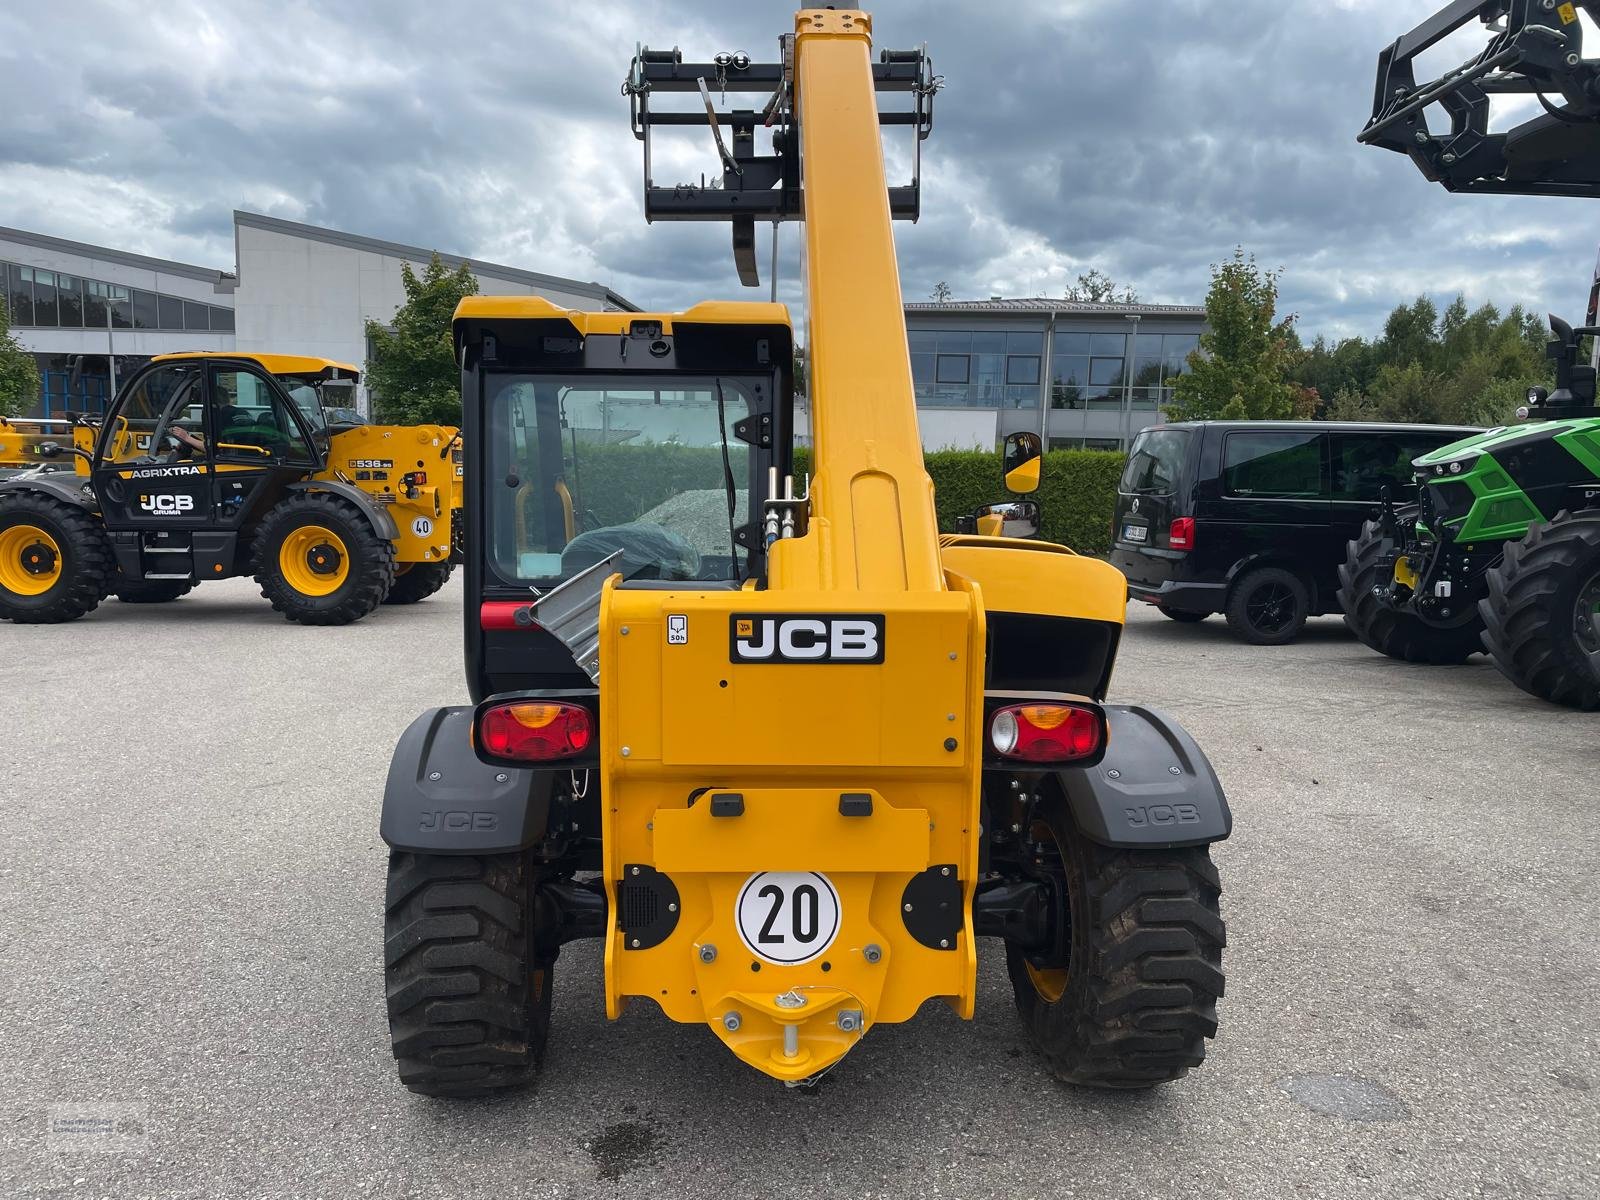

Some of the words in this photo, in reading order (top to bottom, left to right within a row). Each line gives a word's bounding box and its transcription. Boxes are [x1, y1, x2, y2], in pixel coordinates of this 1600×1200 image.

[132, 466, 200, 479] AGRIXTRA
[140, 495, 194, 510] JCB
[416, 520, 429, 533] 40
[736, 619, 878, 659] JCB
[419, 811, 498, 832] JCB
[1123, 803, 1200, 828] JCB
[758, 884, 818, 944] 20
